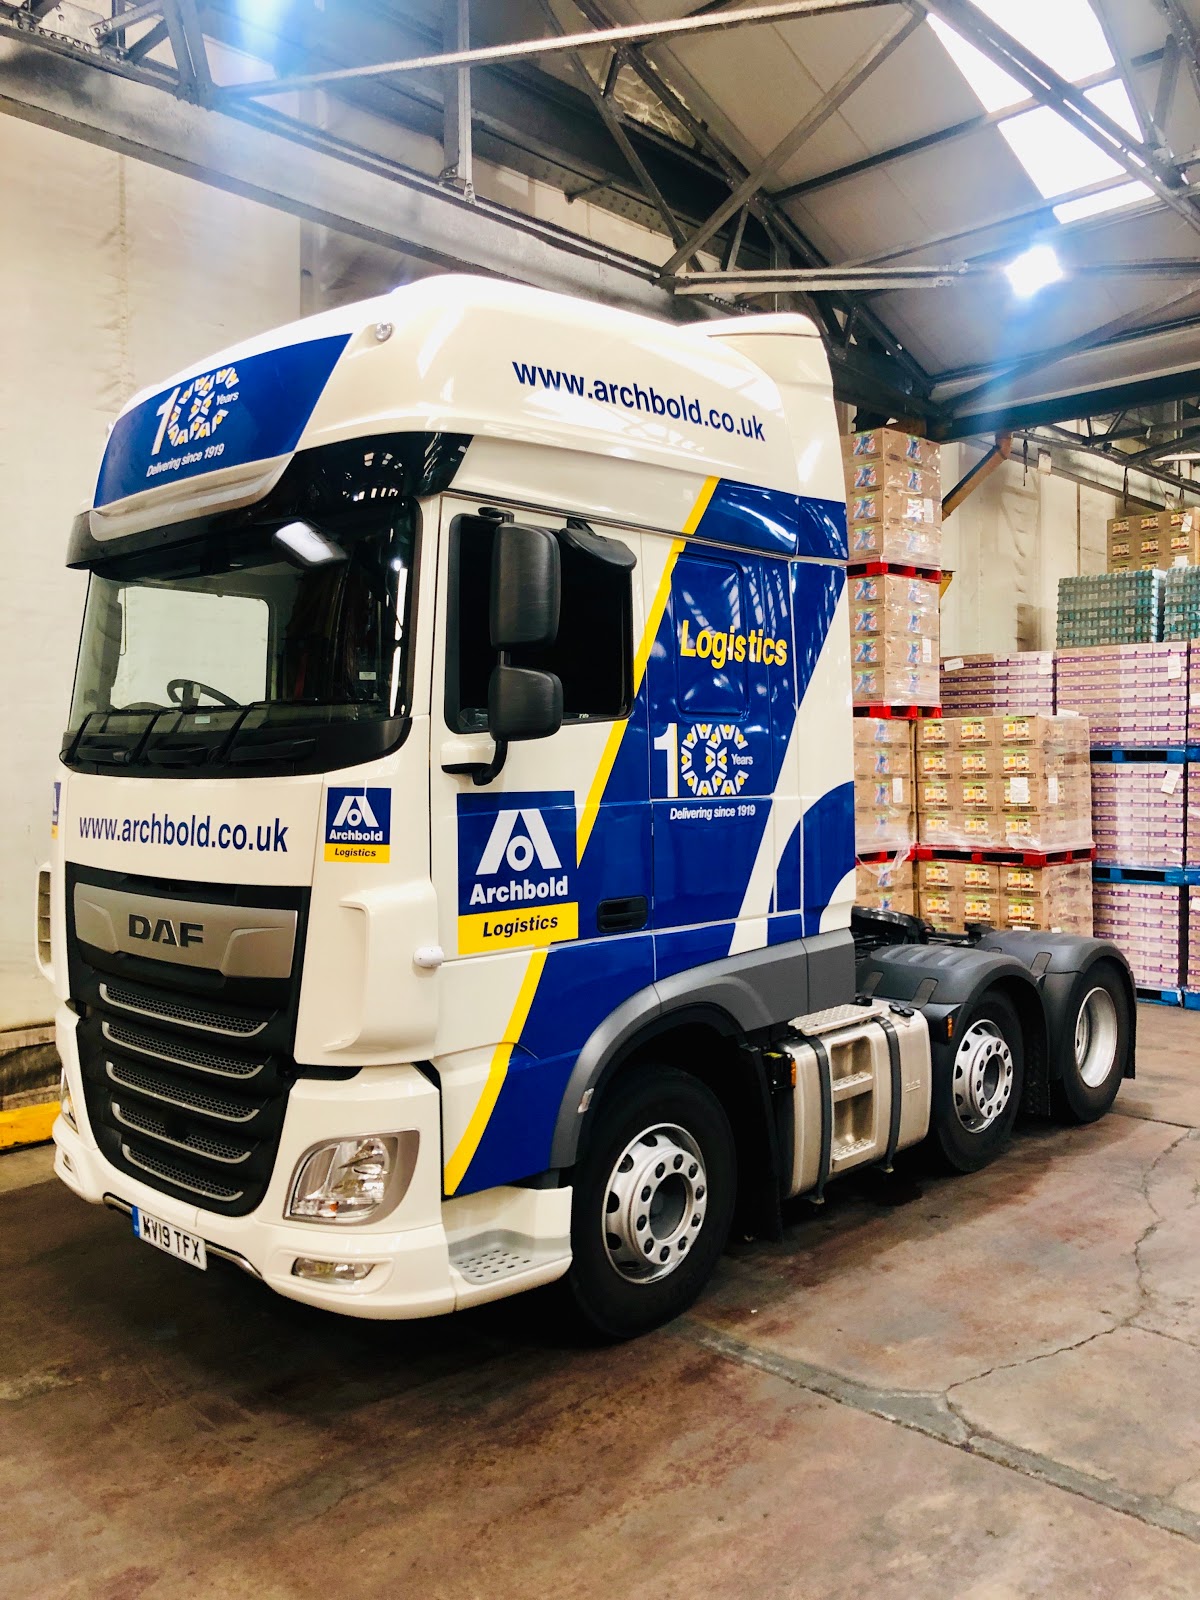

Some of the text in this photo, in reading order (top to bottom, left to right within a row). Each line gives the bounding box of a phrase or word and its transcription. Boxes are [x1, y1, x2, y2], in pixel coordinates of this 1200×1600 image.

[216, 391, 240, 406] Years
[512, 361, 766, 442] www.archbold.co.uk
[146, 442, 225, 478] Delivering since 1919
[680, 620, 788, 669] Logistics
[731, 753, 754, 766] Years
[670, 804, 756, 820] Delivering since 1919
[79, 813, 289, 853] www.archbold.co.uk
[329, 829, 383, 842] Archbold
[334, 847, 377, 858] Logistics
[469, 875, 569, 906] Archbold
[128, 913, 204, 948] DAF
[482, 915, 559, 938] Logistics
[173, 1230, 201, 1263] TFX
